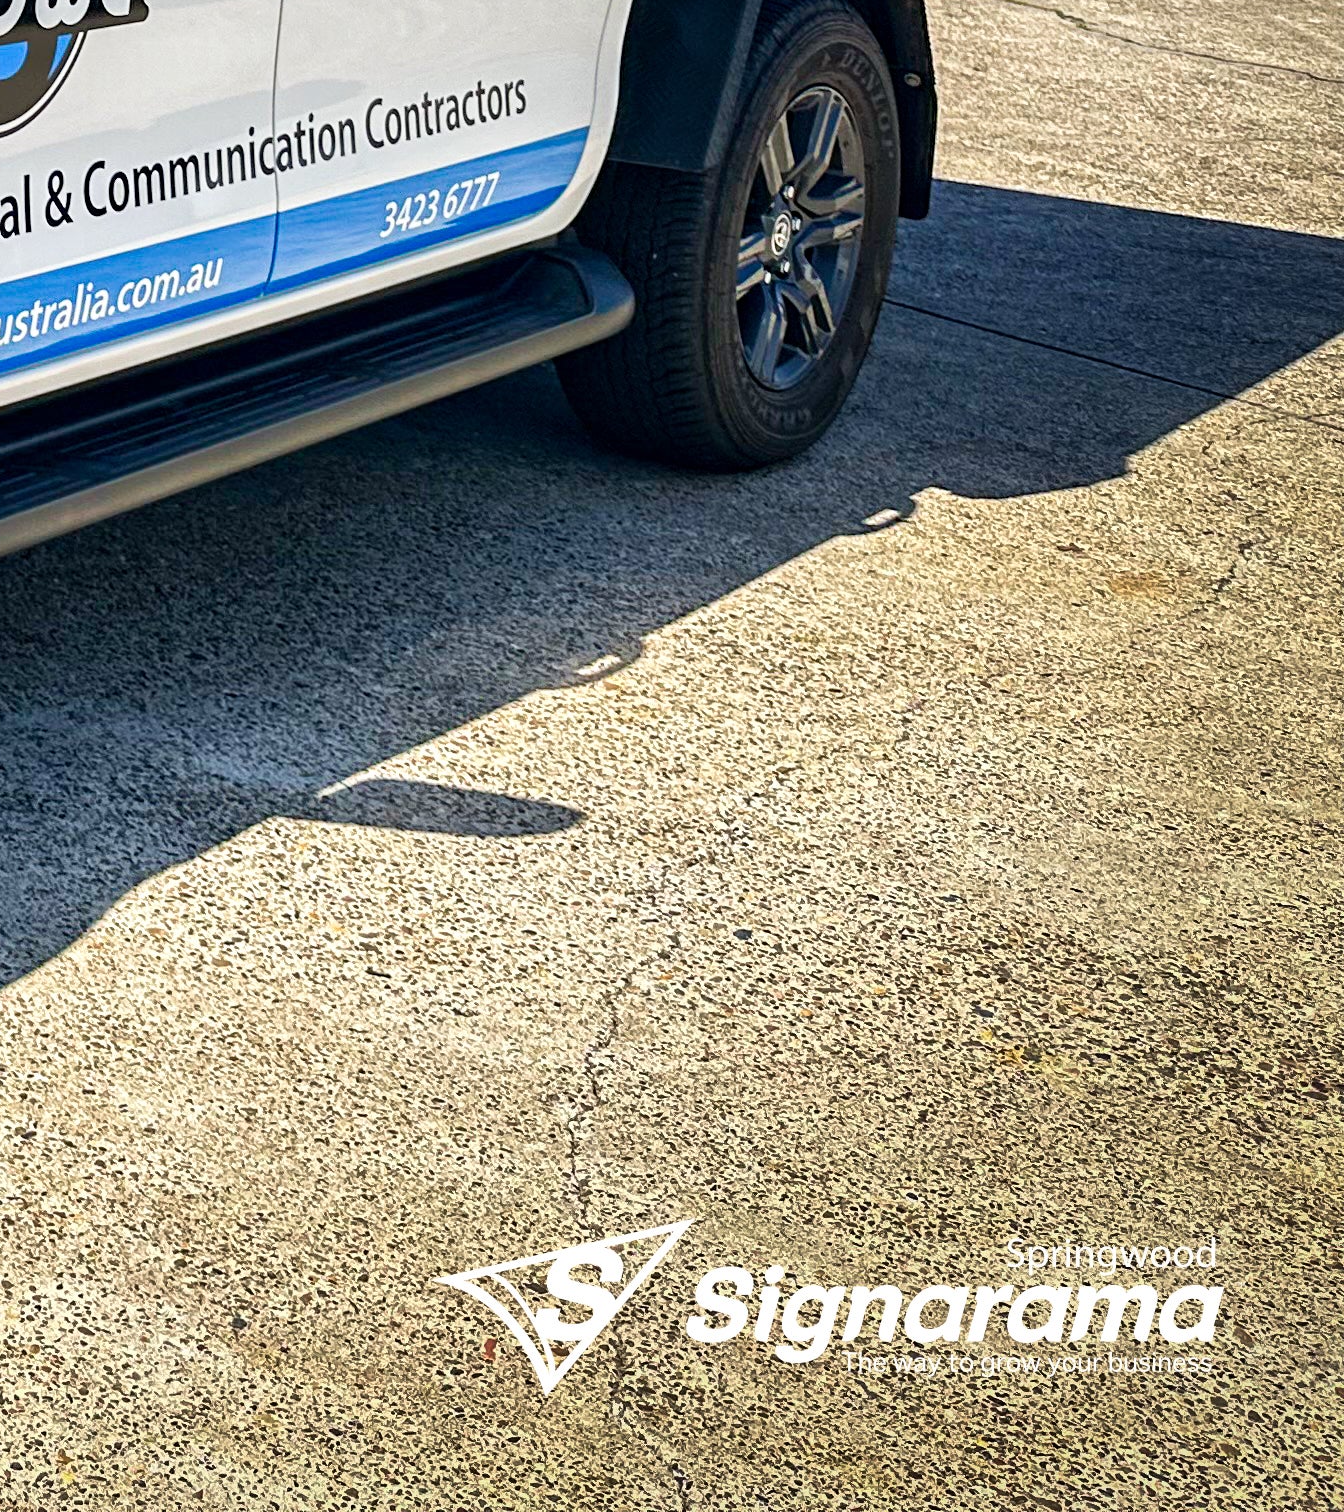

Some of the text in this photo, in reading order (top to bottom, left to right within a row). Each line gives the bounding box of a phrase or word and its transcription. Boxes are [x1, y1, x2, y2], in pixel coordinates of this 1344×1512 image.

[44, 168, 74, 229] &
[83, 112, 357, 219] Communication
[365, 78, 528, 149] Contractors
[379, 171, 500, 239] 3423 6777
